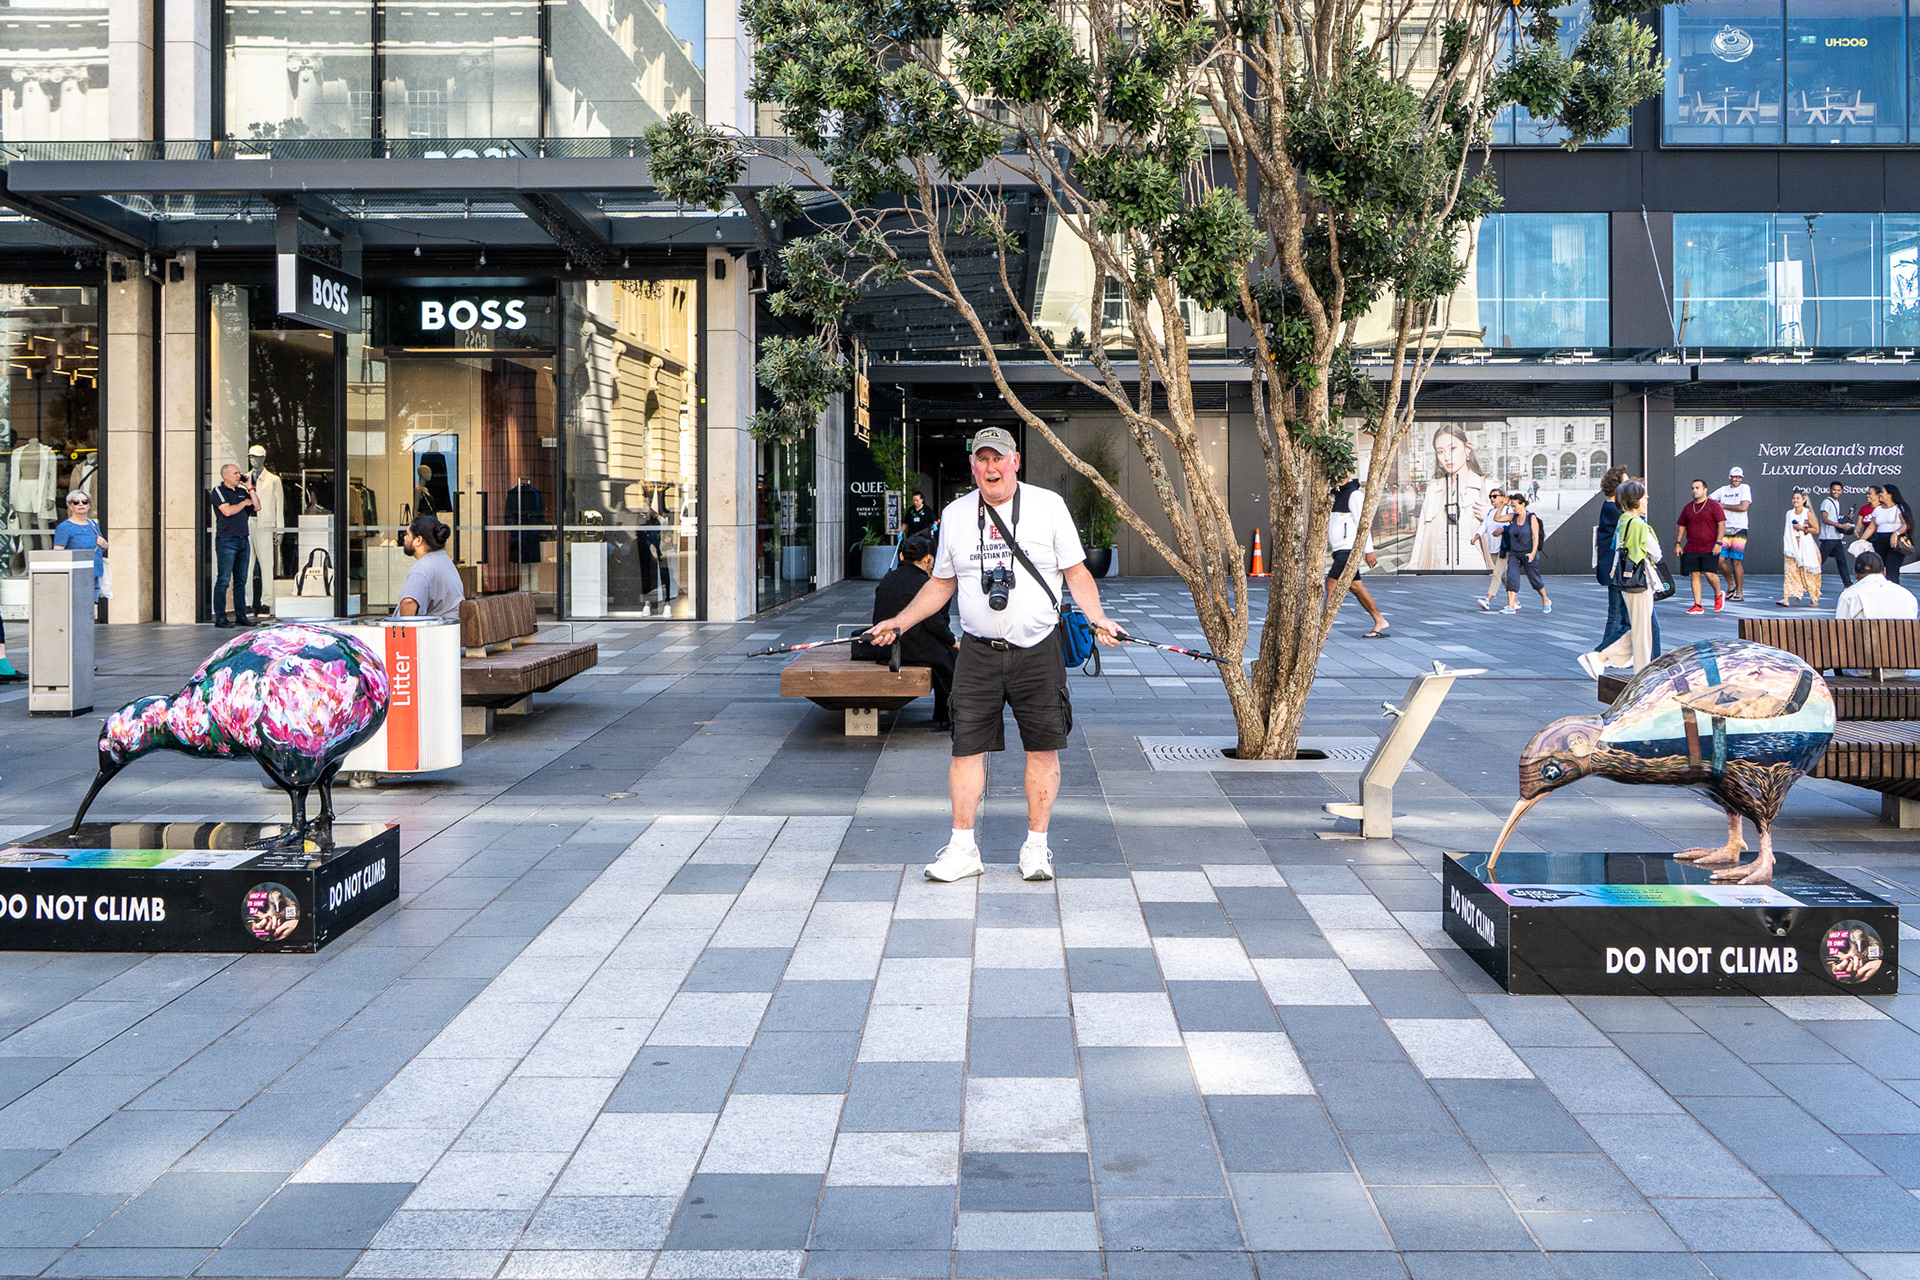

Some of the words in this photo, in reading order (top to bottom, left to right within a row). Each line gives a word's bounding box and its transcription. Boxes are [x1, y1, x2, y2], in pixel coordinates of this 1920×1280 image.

[312, 274, 349, 315] BOSS
[421, 300, 527, 330] BOSS
[1758, 443, 1791, 456] New
[1794, 443, 1865, 456] Zealand's
[1869, 443, 1904, 456] most
[1761, 462, 1837, 475] Luxurious
[1840, 462, 1902, 475] Address
[970, 552, 1000, 561] CHRSTIAN
[392, 651, 411, 706] Litter
[329, 886, 343, 911] DO
[344, 870, 362, 902] NOT
[363, 857, 386, 890] CLIMB
[35, 895, 88, 920] NOT
[94, 895, 166, 922] CLIMB
[1450, 885, 1460, 915] DO
[1461, 895, 1475, 928] NOT
[1476, 908, 1495, 947] CLIMB
[1606, 946, 1646, 974] DO
[1655, 946, 1712, 974] NOT
[1720, 946, 1799, 974] CLIMB
